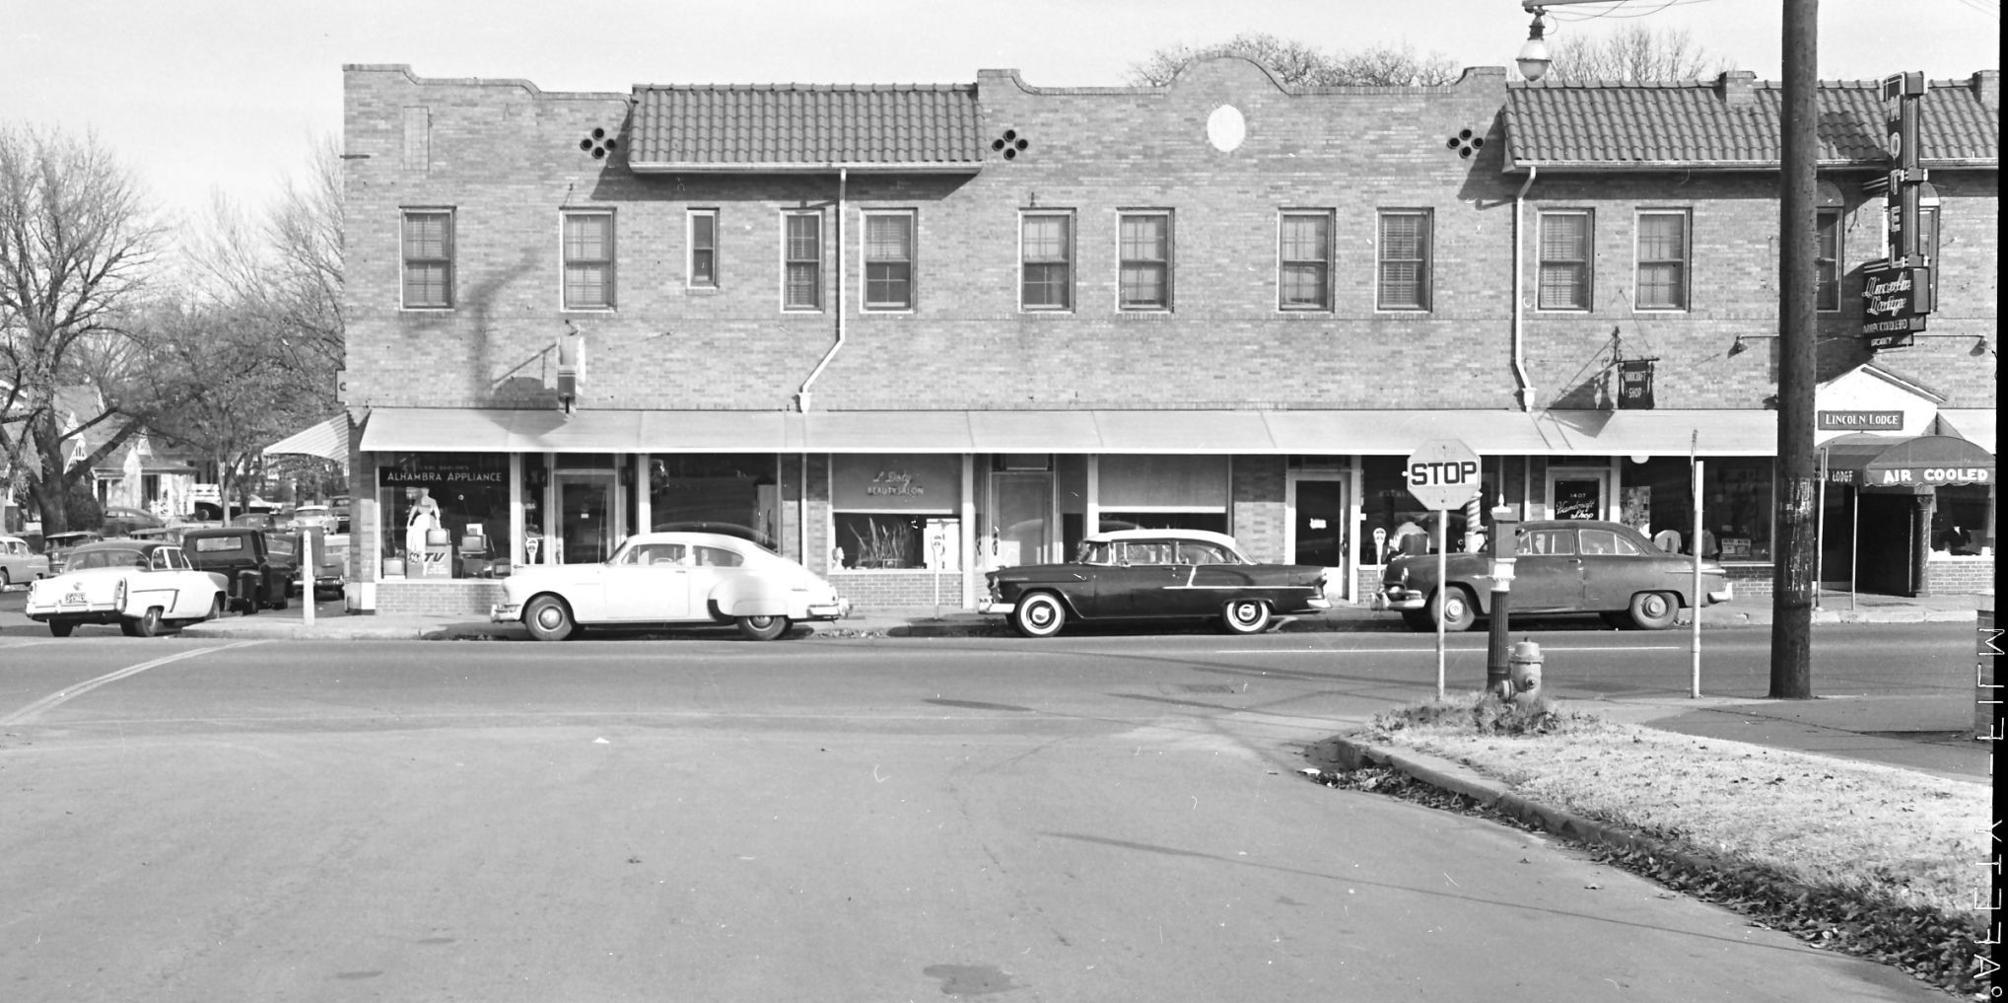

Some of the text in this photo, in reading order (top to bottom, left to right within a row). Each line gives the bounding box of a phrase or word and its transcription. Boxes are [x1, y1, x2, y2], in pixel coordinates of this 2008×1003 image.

[1629, 387, 1642, 399] SHOP
[1825, 413, 1899, 426] LINCOLN LODGE
[387, 472, 502, 482] ALHAMBRA APPLIANCE
[1411, 461, 1477, 485] STOP
[1832, 470, 1854, 483] LODGE
[1883, 468, 1989, 484] AIR COOLED
[867, 487, 924, 496] BEAUTY SALON
[1570, 507, 1594, 520] Shop
[424, 552, 446, 562] TV
